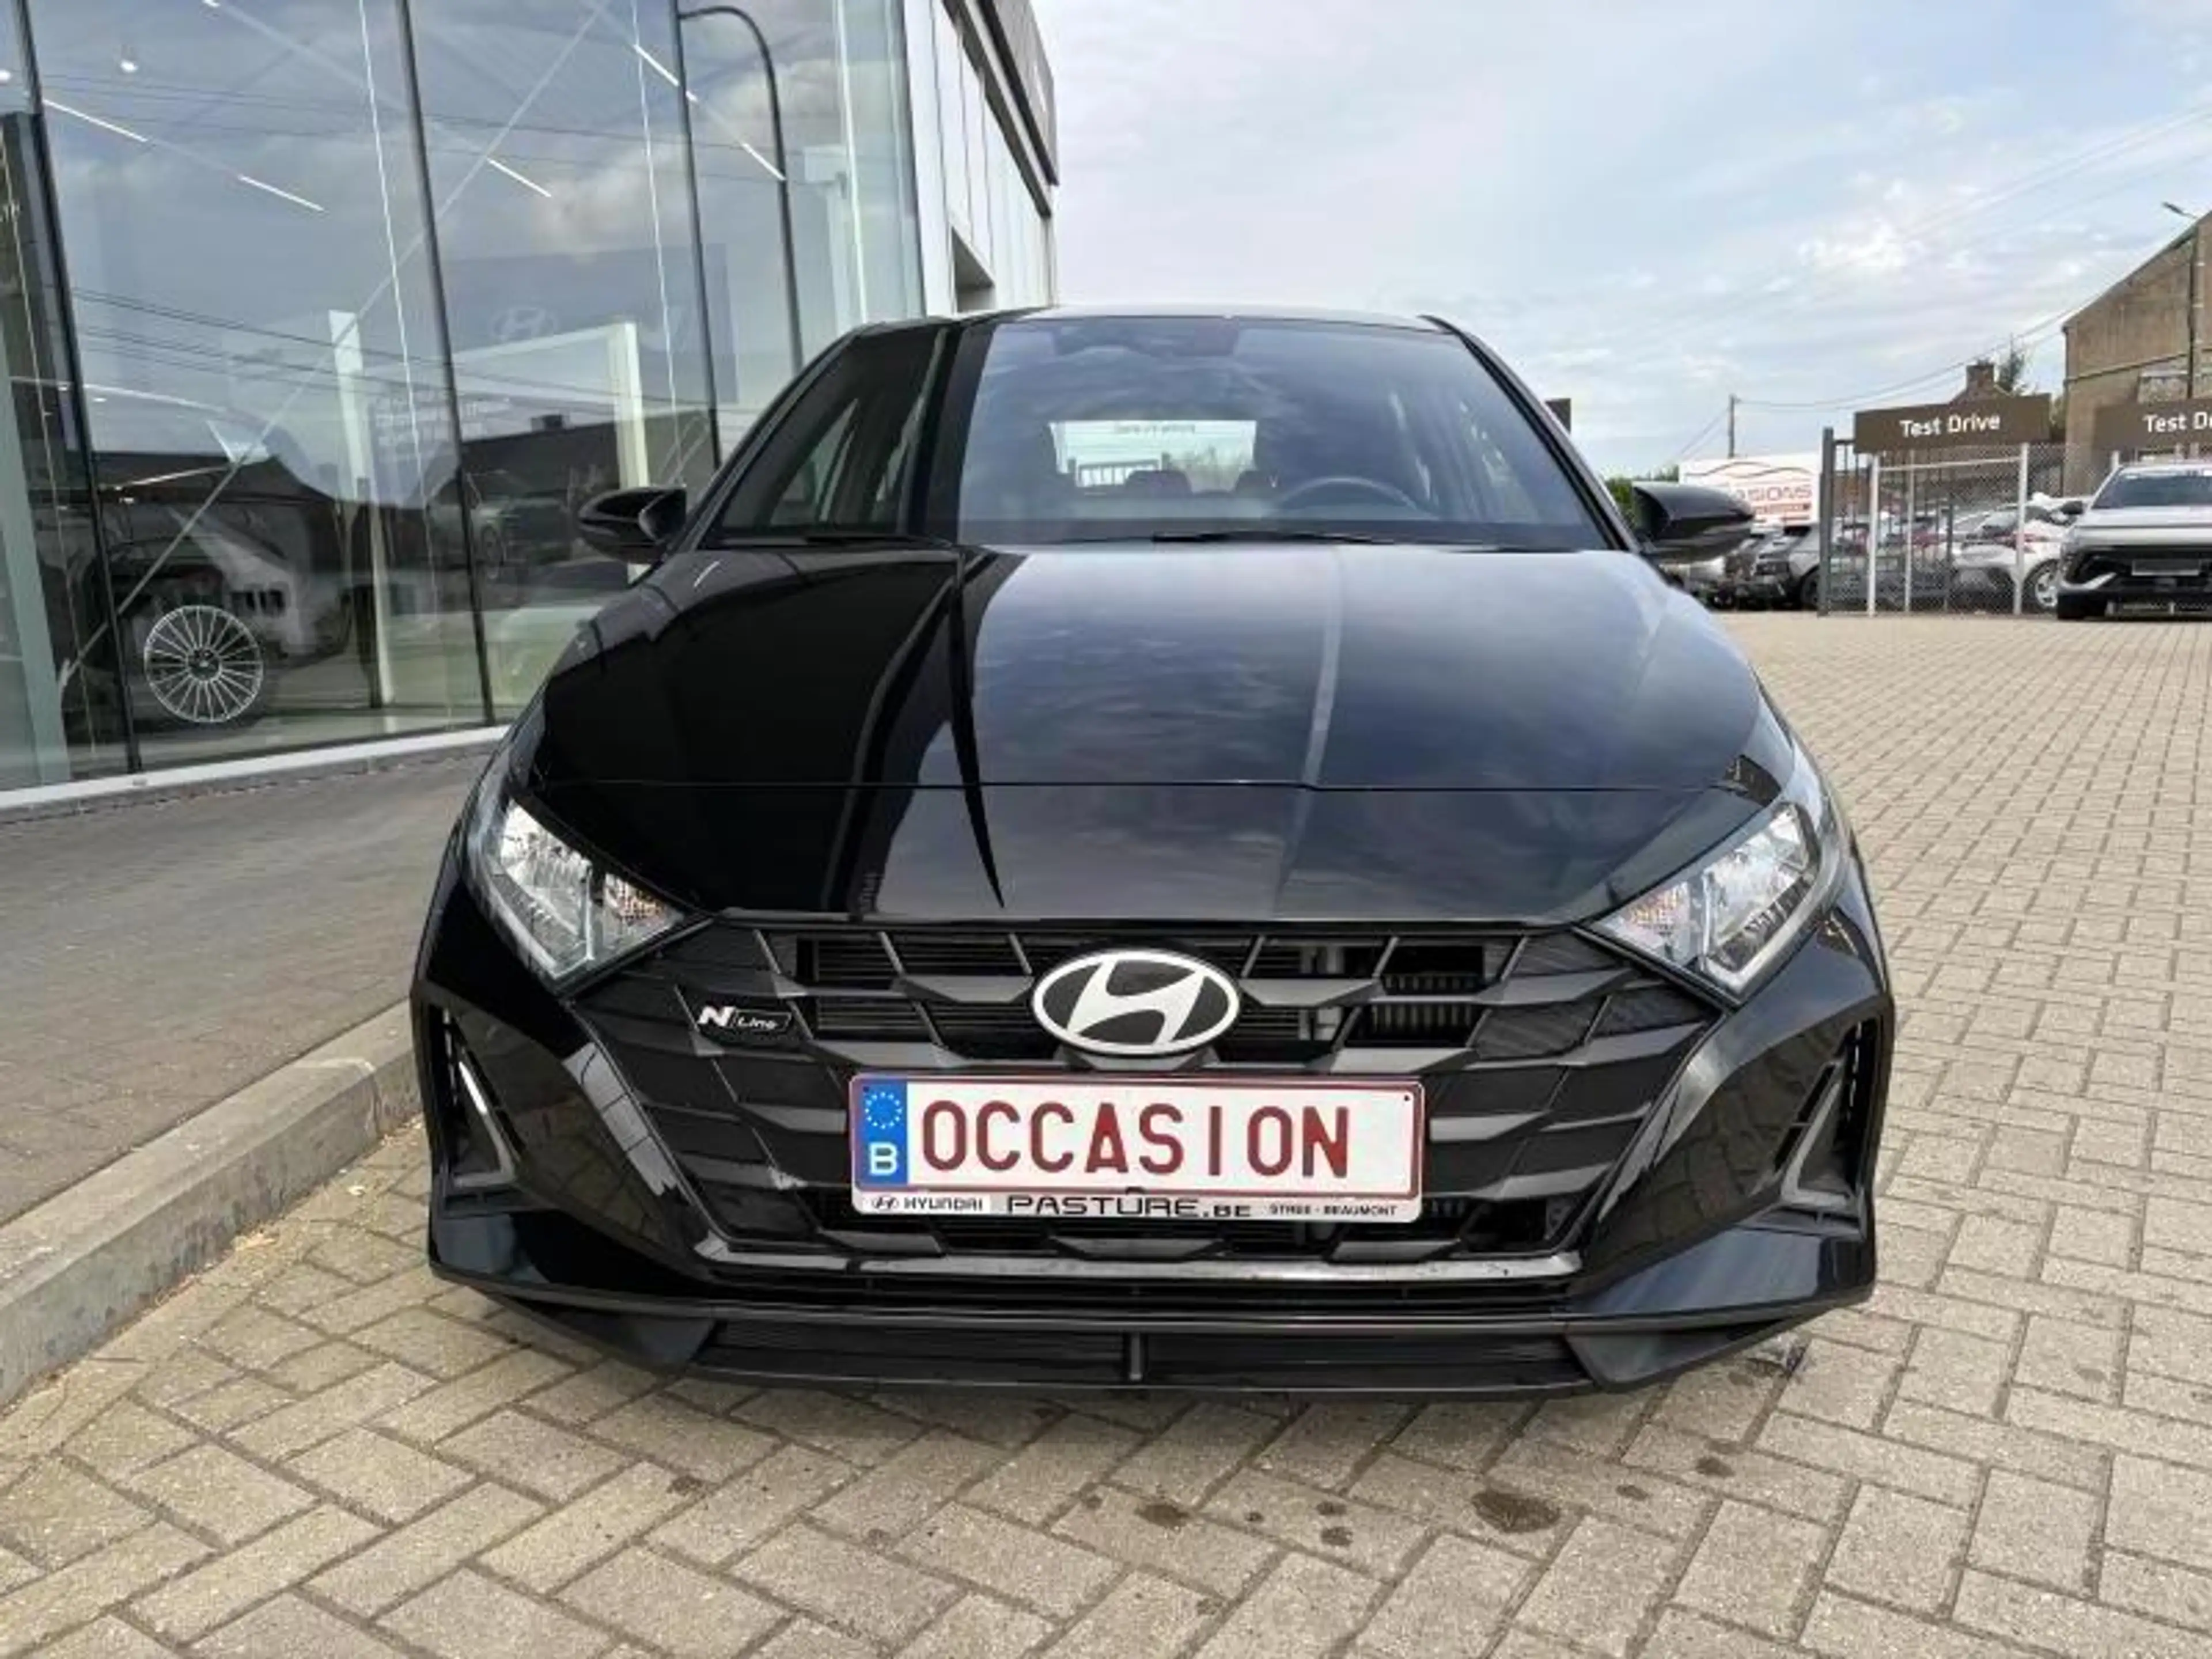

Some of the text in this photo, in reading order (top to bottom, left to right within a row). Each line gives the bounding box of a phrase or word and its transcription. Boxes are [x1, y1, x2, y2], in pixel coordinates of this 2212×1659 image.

[1900, 412, 2001, 438] Test Drive
[2142, 412, 2187, 433] Test
[697, 1006, 736, 1027] N
[922, 1100, 1349, 1177] OCCASION
[869, 1141, 898, 1176] B
[903, 1196, 983, 1211] HYUNDAI
[1323, 1205, 1398, 1217] BEAUMONT
